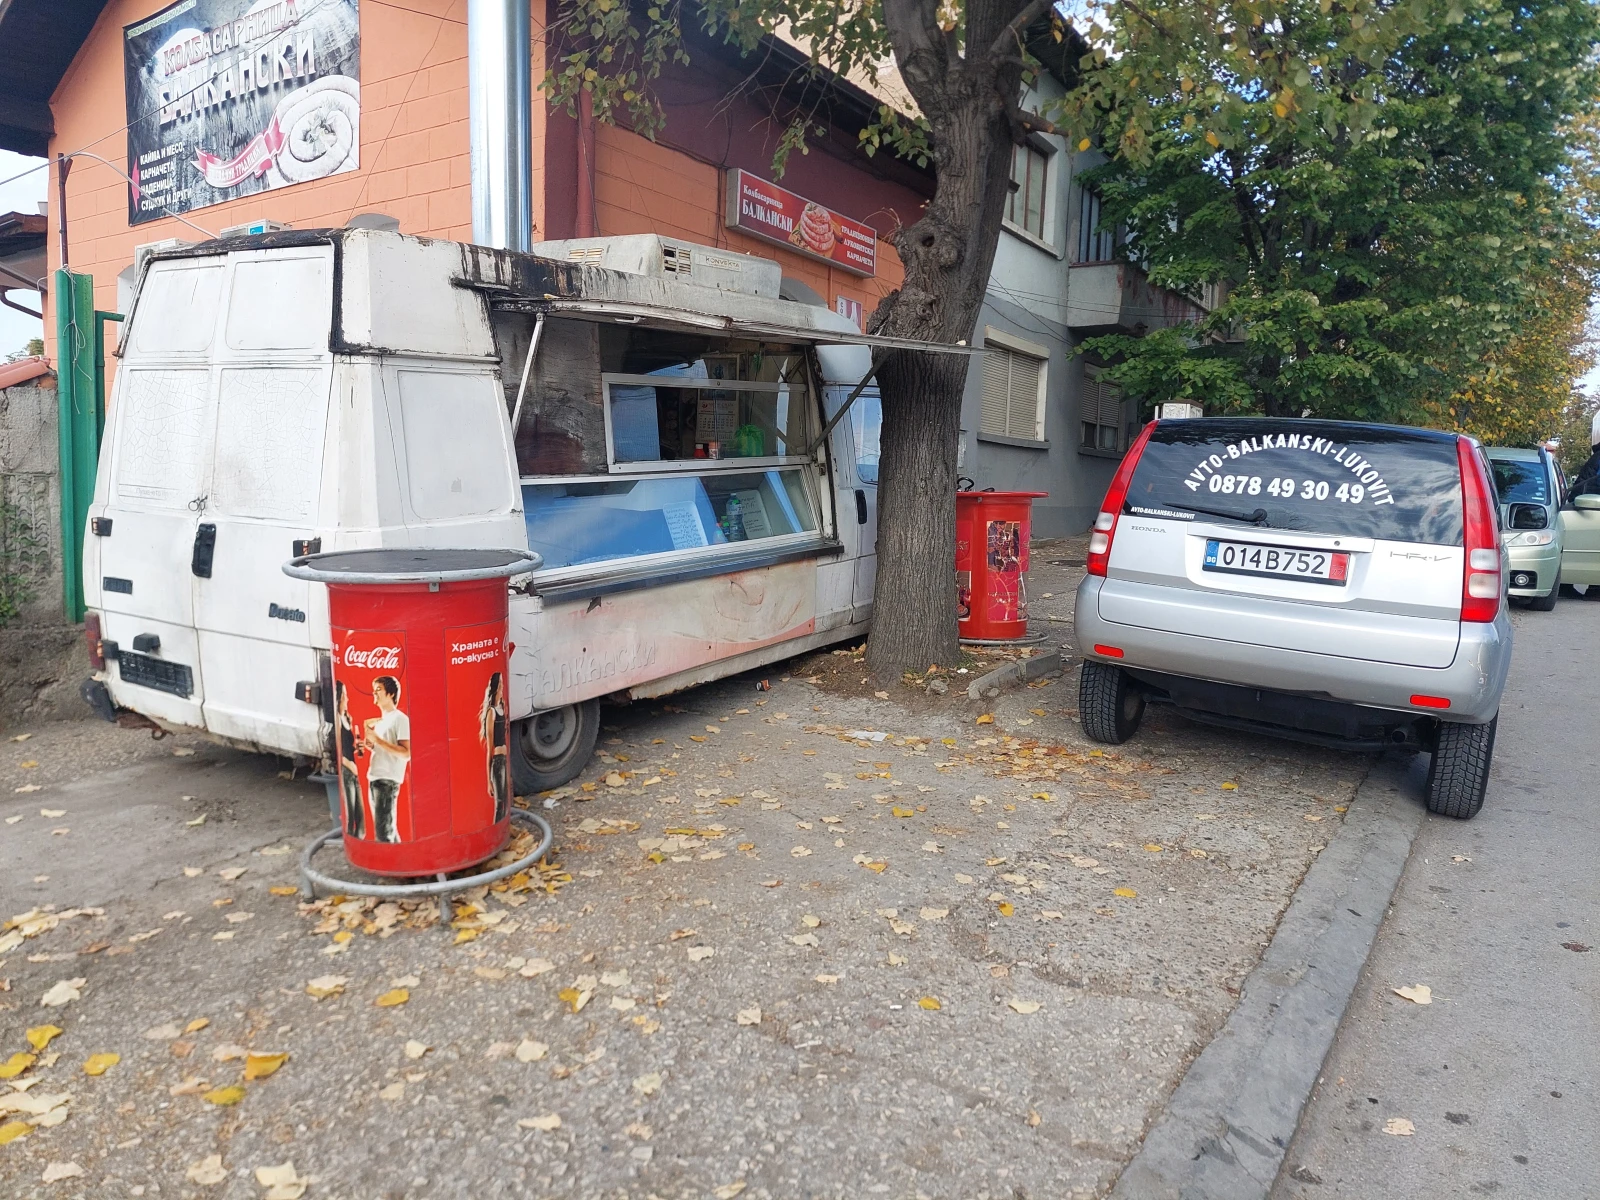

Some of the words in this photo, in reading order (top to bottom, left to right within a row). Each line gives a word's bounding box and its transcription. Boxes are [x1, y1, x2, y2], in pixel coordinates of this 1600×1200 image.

[163, 0, 299, 76] КОЛБАСАРНИЦА
[159, 28, 317, 125] БАЛКАНСКИ
[140, 151, 161, 166] КАЙМА
[161, 148, 167, 159] И
[141, 161, 175, 180] КАРНАЧЕТА
[743, 184, 783, 210] Колбасарница
[742, 198, 793, 233] БАЛКАНСКИ
[1184, 433, 1395, 507] AVTO-BALKANSKI-LUKOVIT
[1209, 474, 1262, 495] 0878
[1267, 477, 1295, 498] 49
[1300, 480, 1330, 501] 30
[1335, 482, 1365, 504] 49
[1131, 506, 1196, 519] AVTO-BALKANSKI-LUKOVIT
[1131, 525, 1167, 534] HONDA
[1206, 556, 1217, 564] BG
[1222, 546, 1326, 576] 014B752
[1389, 551, 1453, 562] HR-V
[269, 602, 306, 623] Ducato
[451, 639, 493, 653] Храната
[493, 636, 499, 645] е
[344, 645, 401, 669] Coca-Cola
[451, 651, 494, 665] по-вкусна
[494, 649, 499, 657] с
